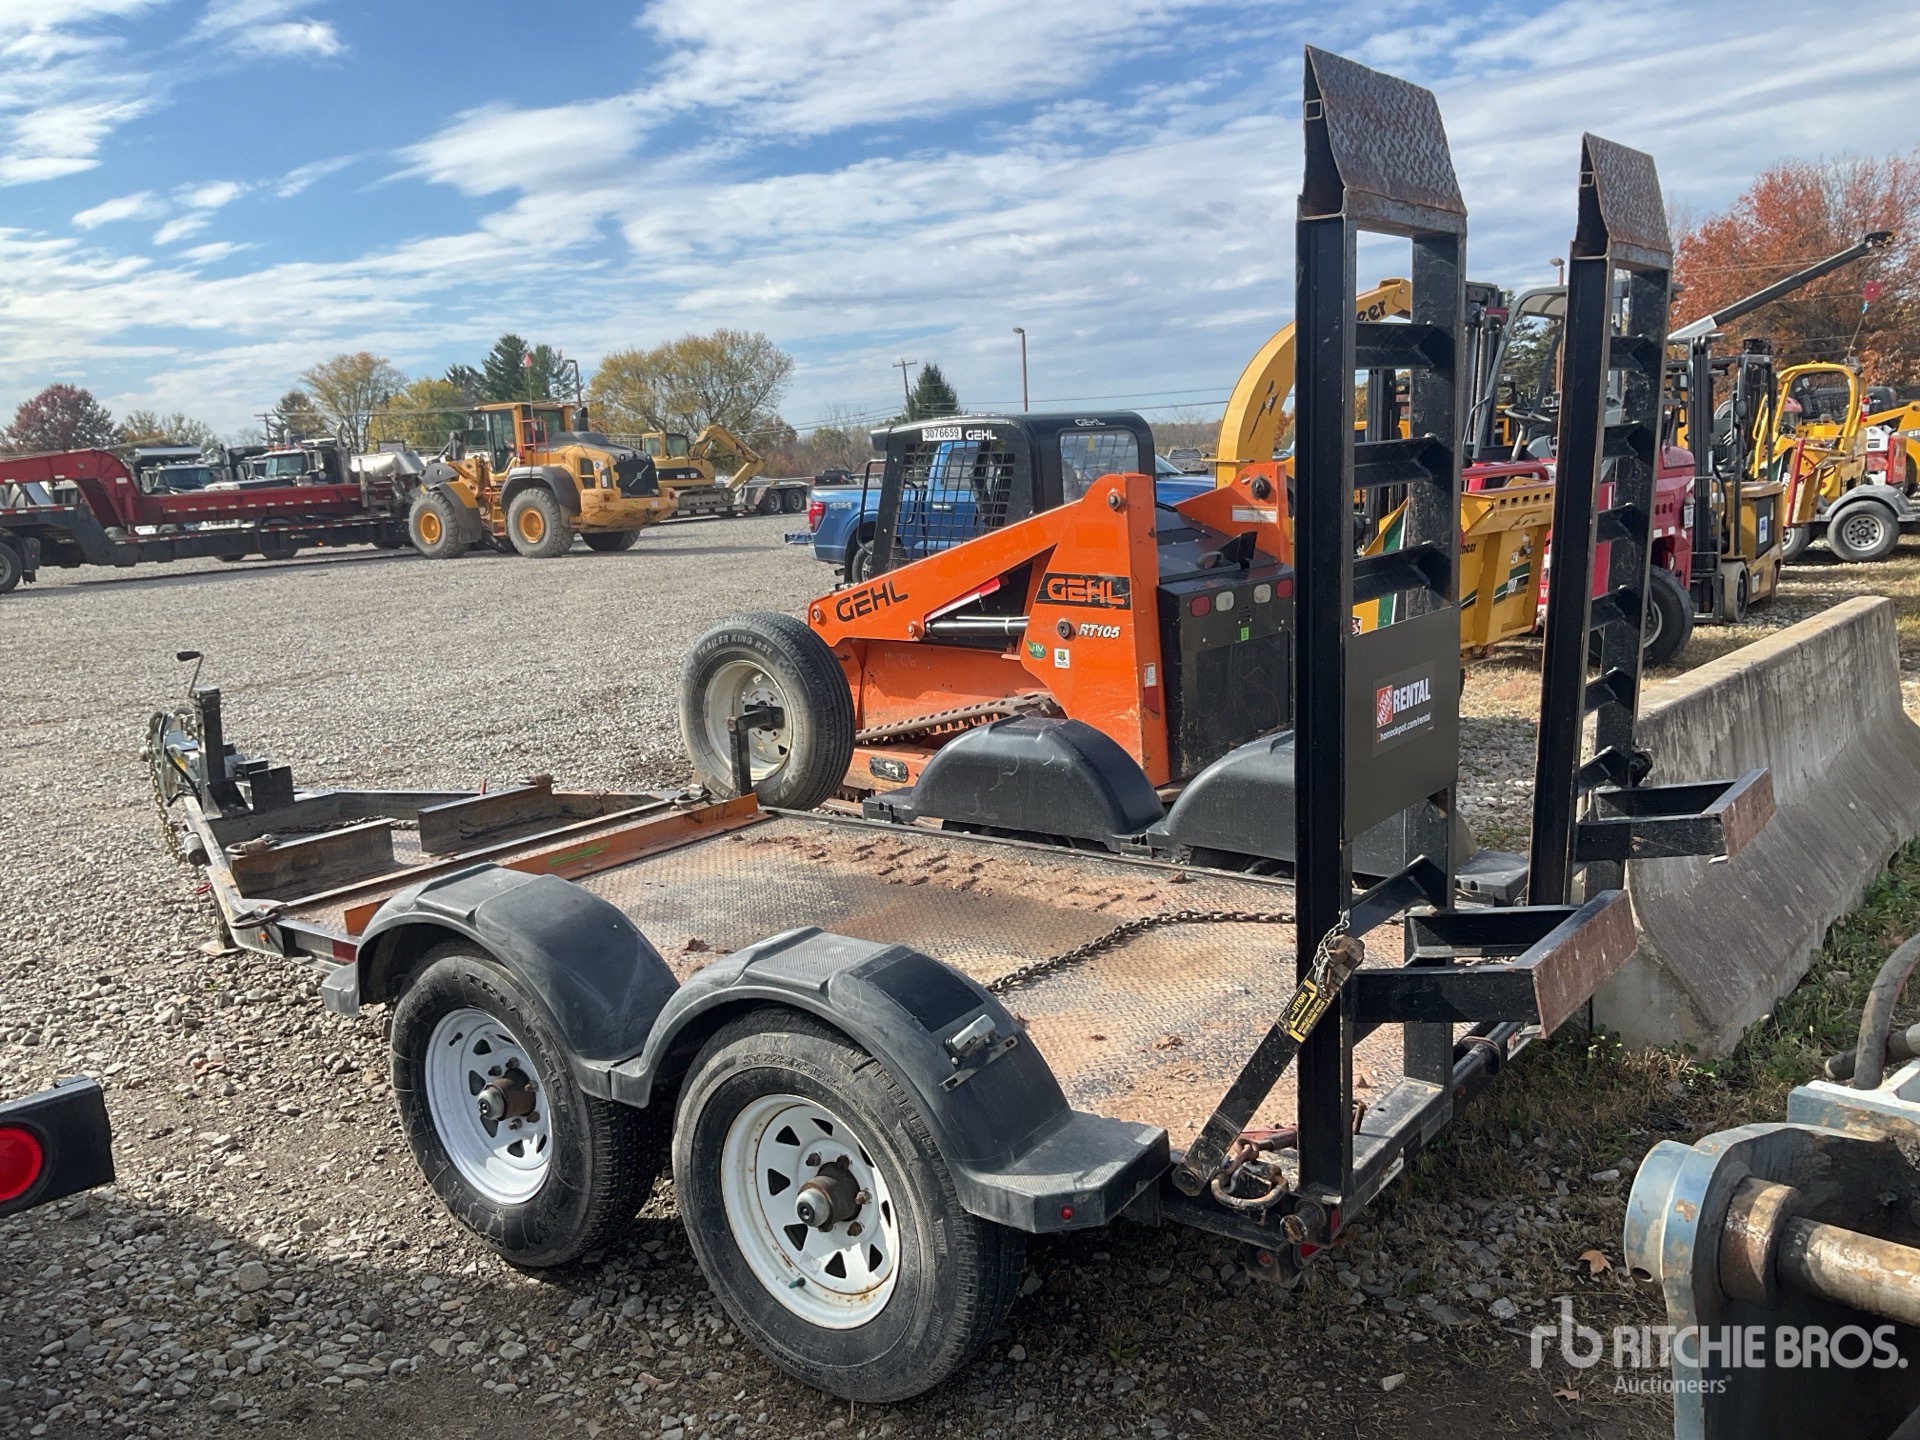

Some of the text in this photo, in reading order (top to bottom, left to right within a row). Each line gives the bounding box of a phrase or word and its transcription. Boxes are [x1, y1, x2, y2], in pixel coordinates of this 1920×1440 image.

[1356, 300, 1385, 321] eer
[924, 429, 959, 439] 3076659
[966, 430, 997, 440] GEHL
[836, 580, 908, 622] GEHL
[1047, 578, 1125, 605] GEHL
[1078, 623, 1121, 638] RT105
[698, 633, 773, 657] TRAILER KING RST
[1393, 678, 1431, 714] RENTAL
[1288, 992, 1308, 1020] UTION
